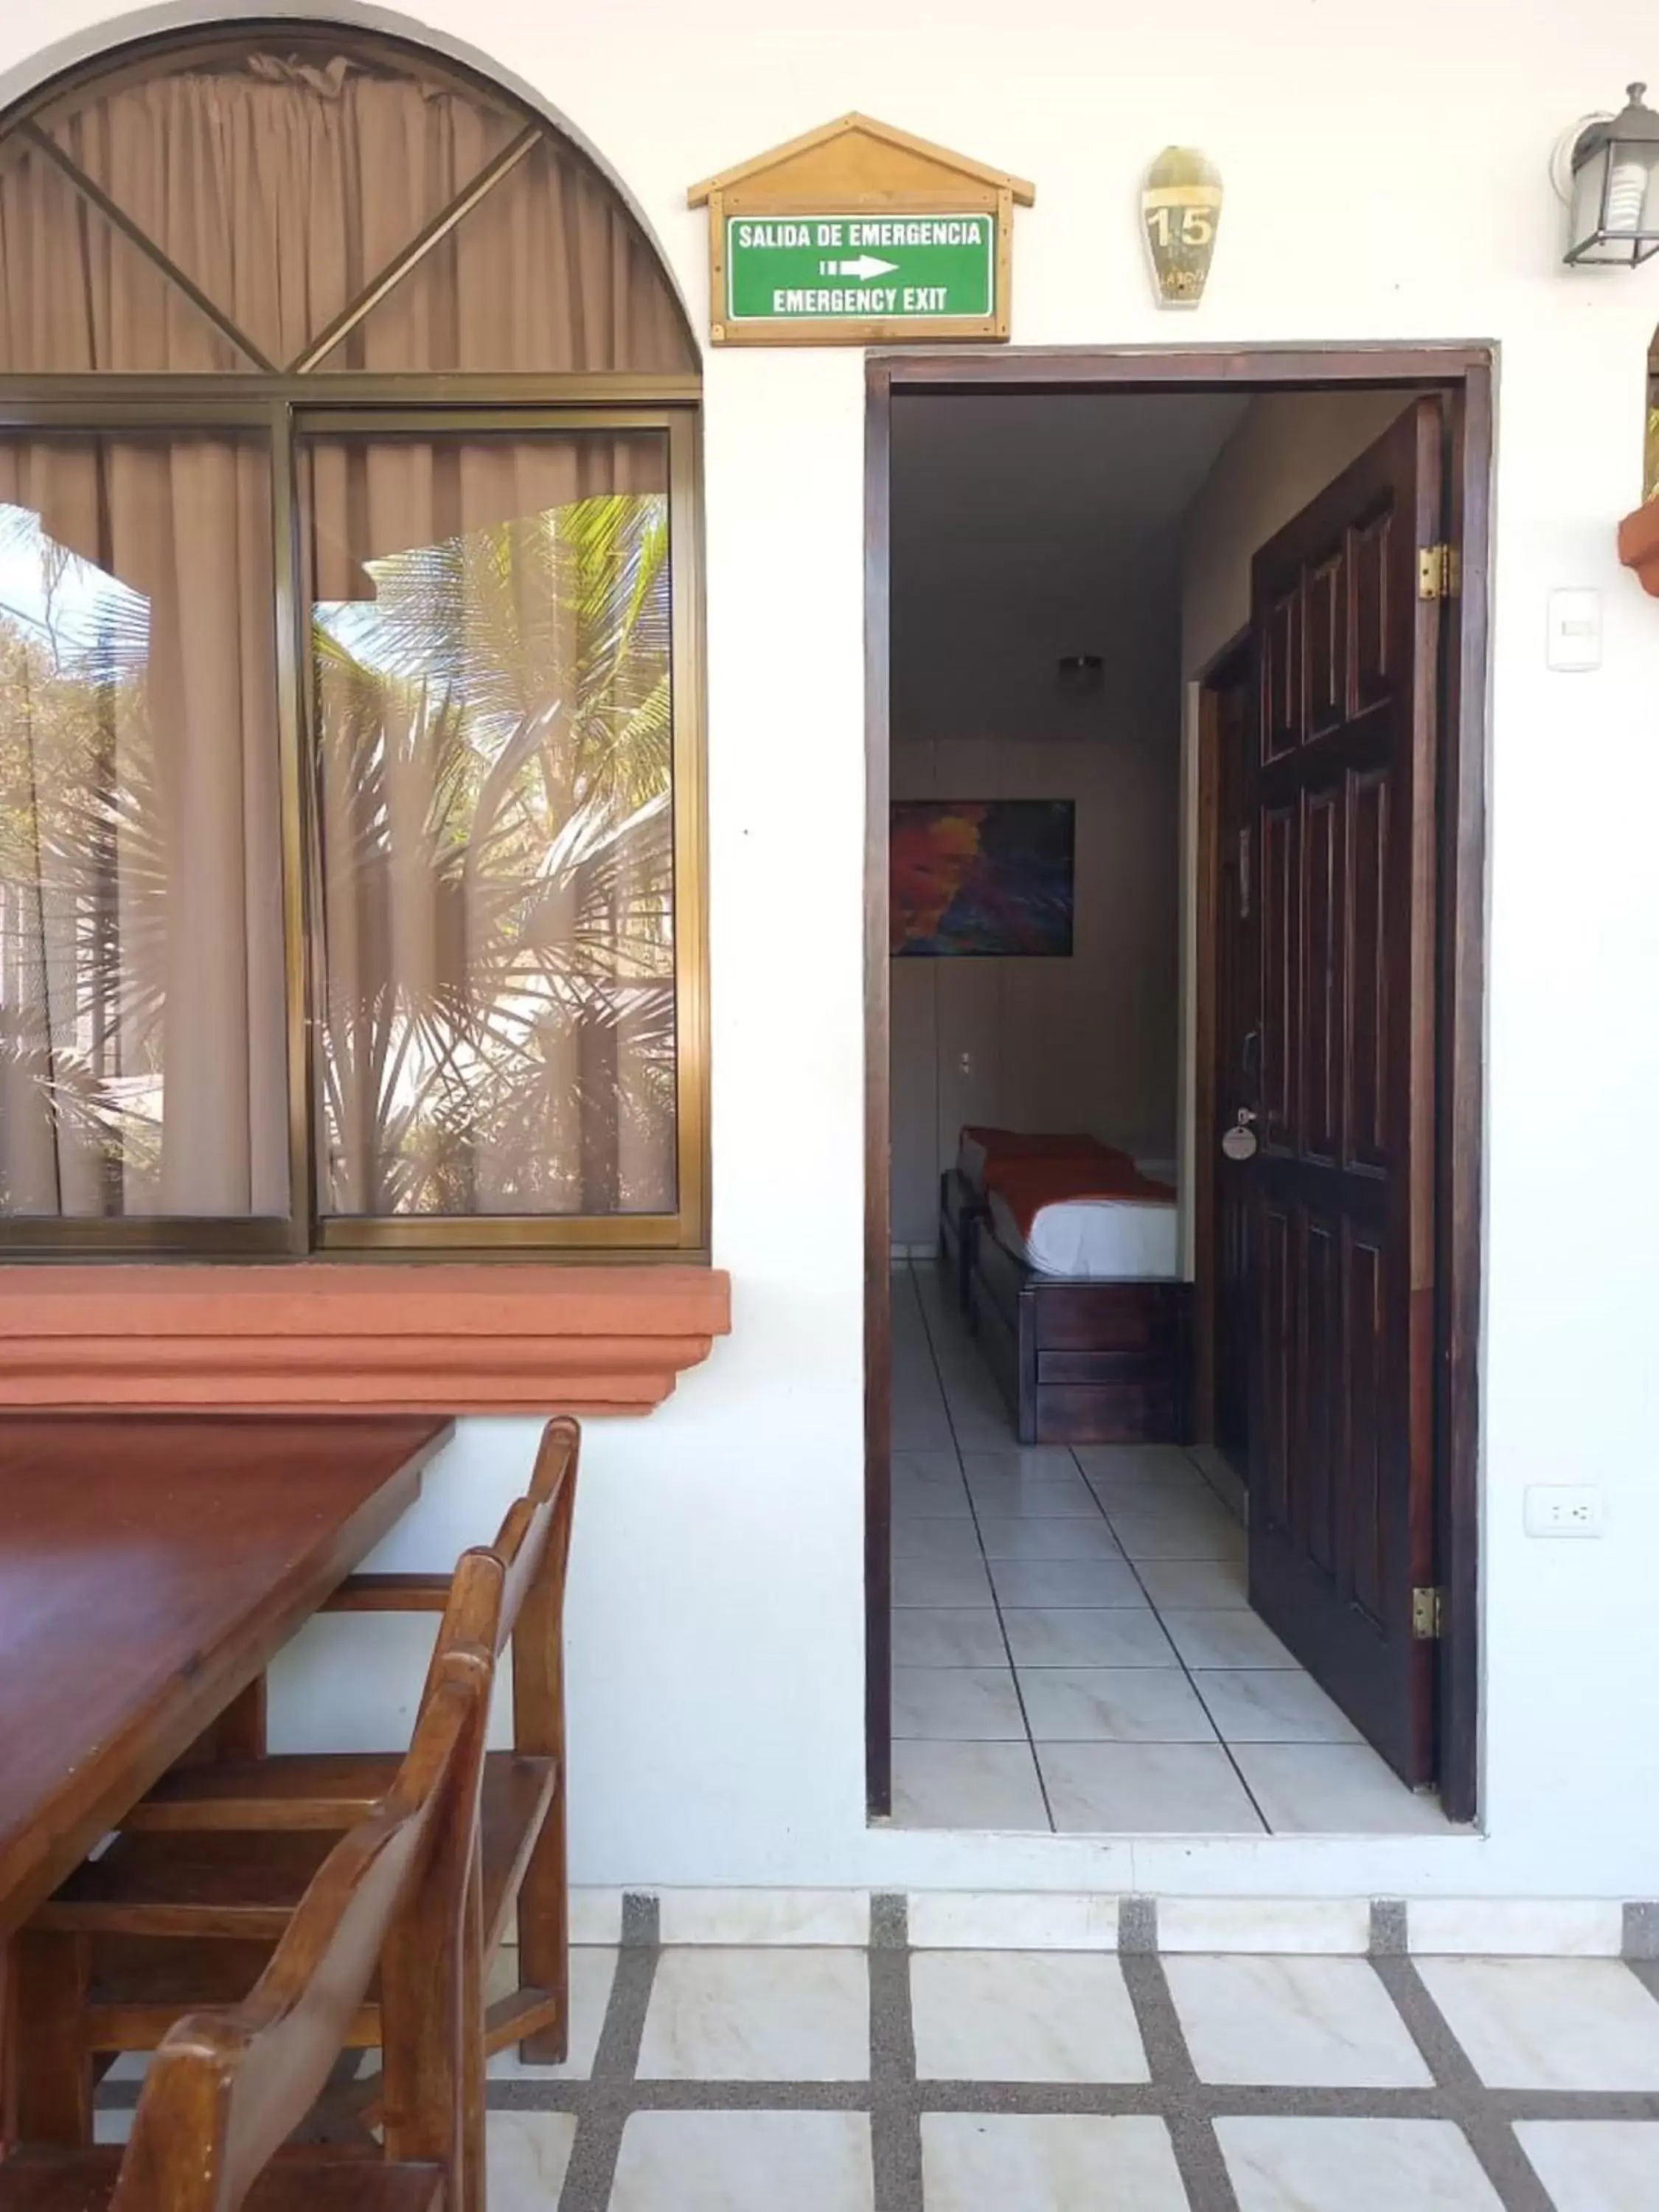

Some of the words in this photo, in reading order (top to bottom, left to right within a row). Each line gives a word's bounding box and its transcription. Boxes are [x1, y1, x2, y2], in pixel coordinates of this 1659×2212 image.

[739, 223, 812, 248] SALIDA
[817, 223, 842, 246] DE
[849, 223, 982, 246] EMERGENCIA
[1148, 207, 1212, 247] 15
[773, 288, 897, 313] EMERGENCY
[903, 287, 947, 311] EXIT
